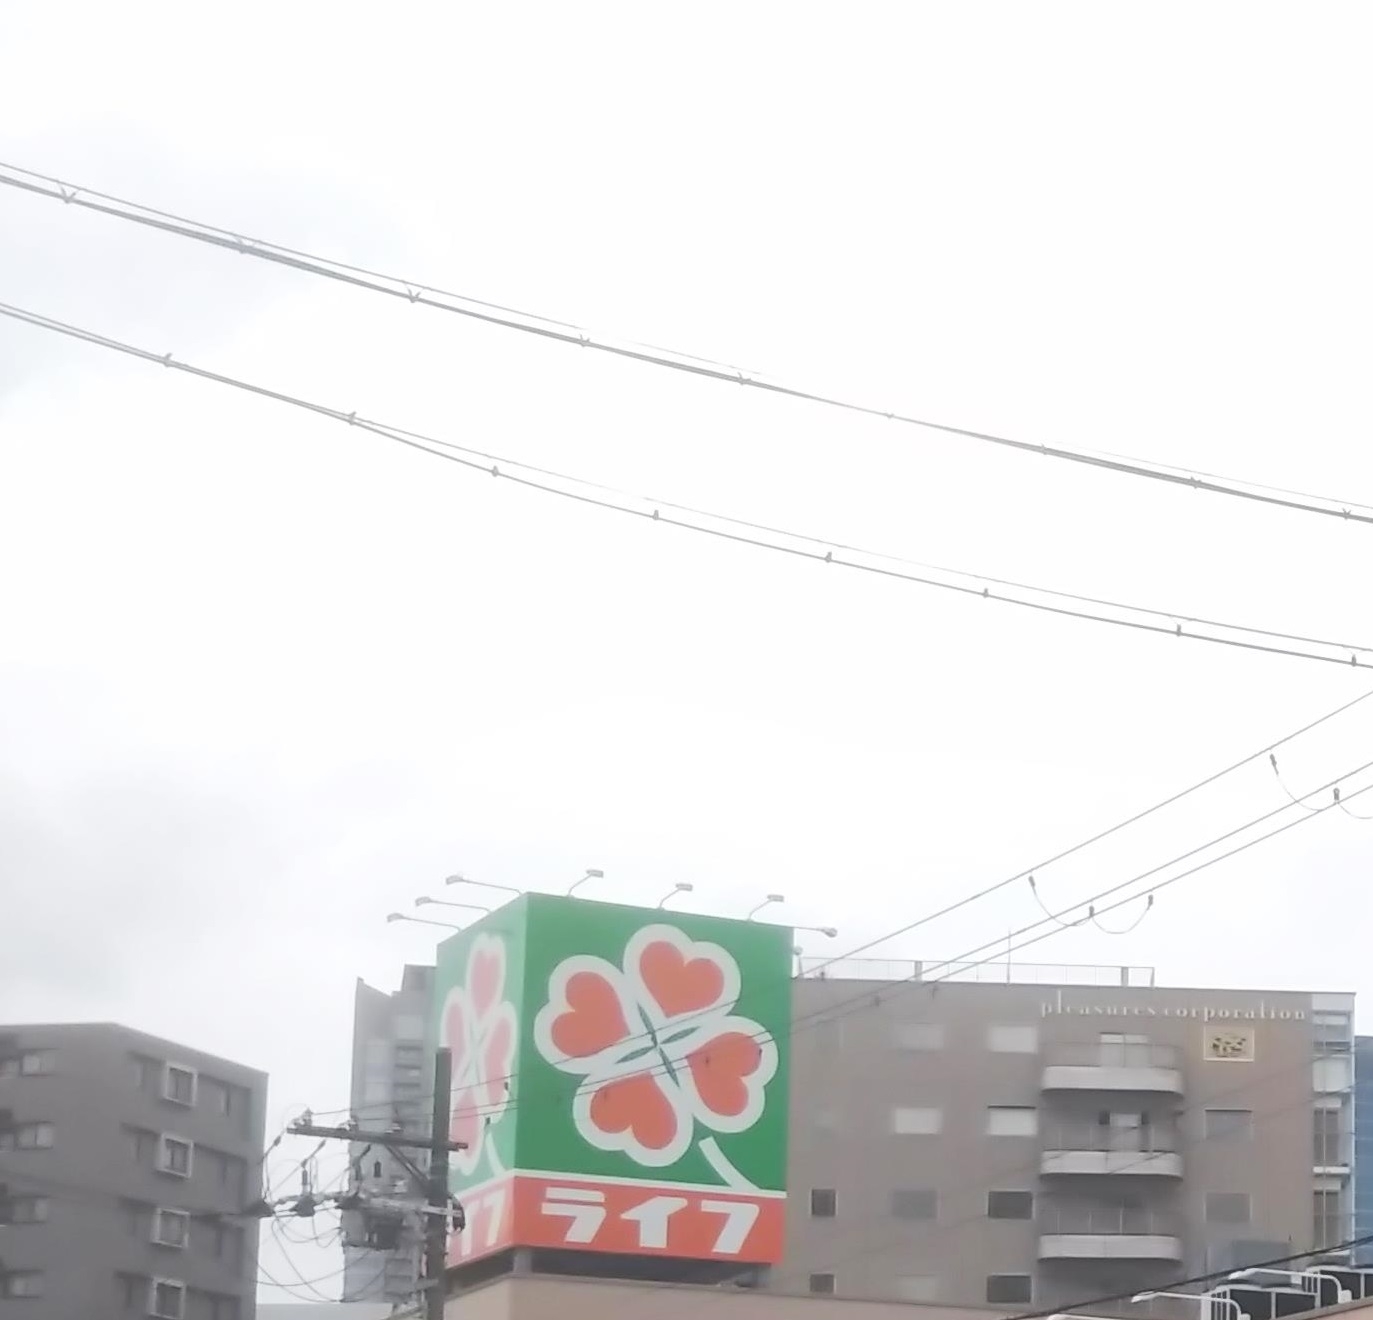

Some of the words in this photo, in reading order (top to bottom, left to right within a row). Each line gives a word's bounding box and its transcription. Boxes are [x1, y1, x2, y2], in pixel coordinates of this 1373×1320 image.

[1041, 990, 1156, 1018] pleasures
[1164, 1001, 1306, 1022] corporation
[541, 1186, 760, 1255] ライフ
